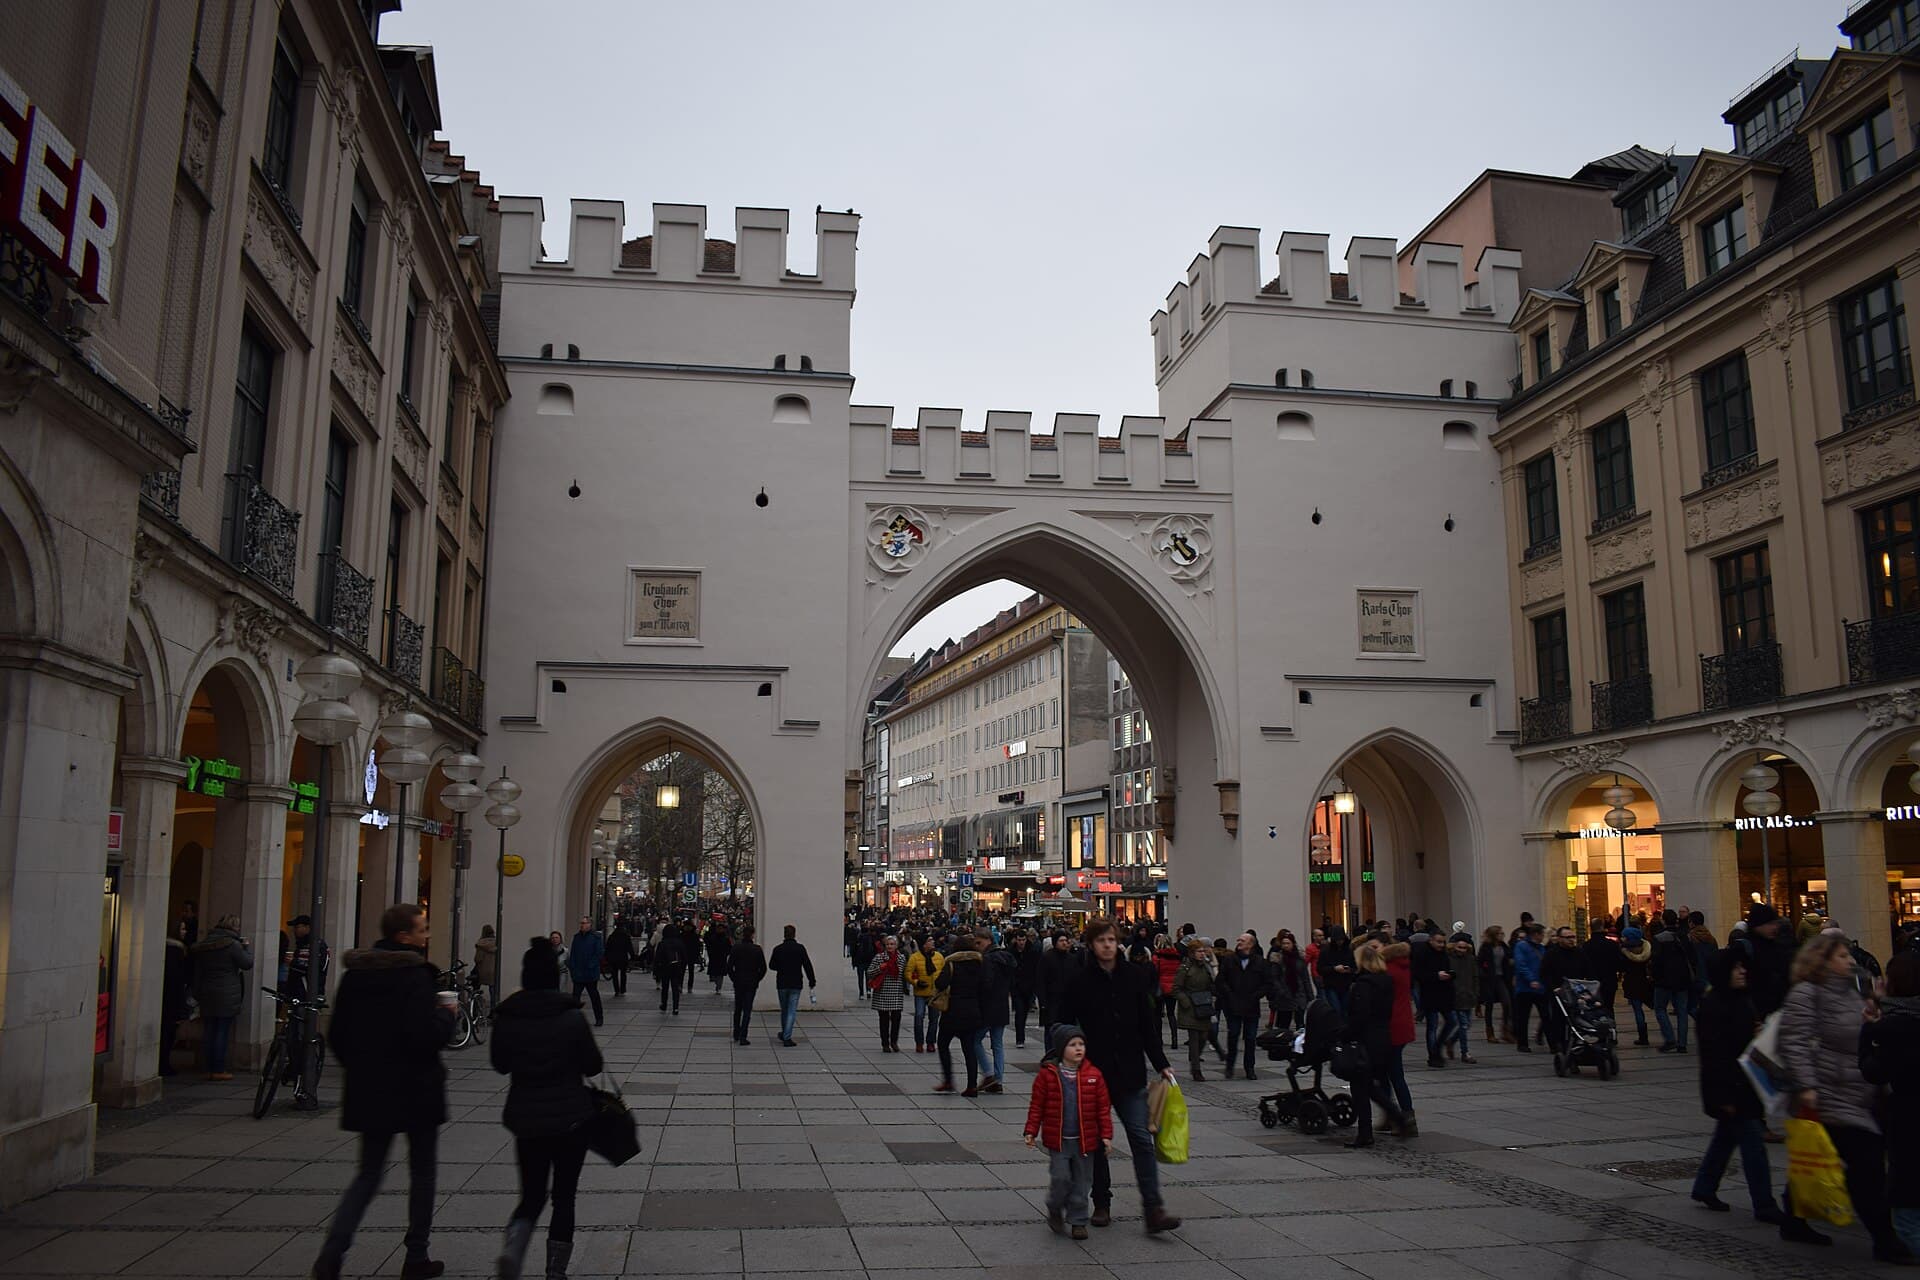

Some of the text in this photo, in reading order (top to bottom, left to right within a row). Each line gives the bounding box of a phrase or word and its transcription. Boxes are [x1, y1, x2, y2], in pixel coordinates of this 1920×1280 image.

[653, 596, 678, 610] Thor
[1361, 599, 1413, 617] Karls Thor
